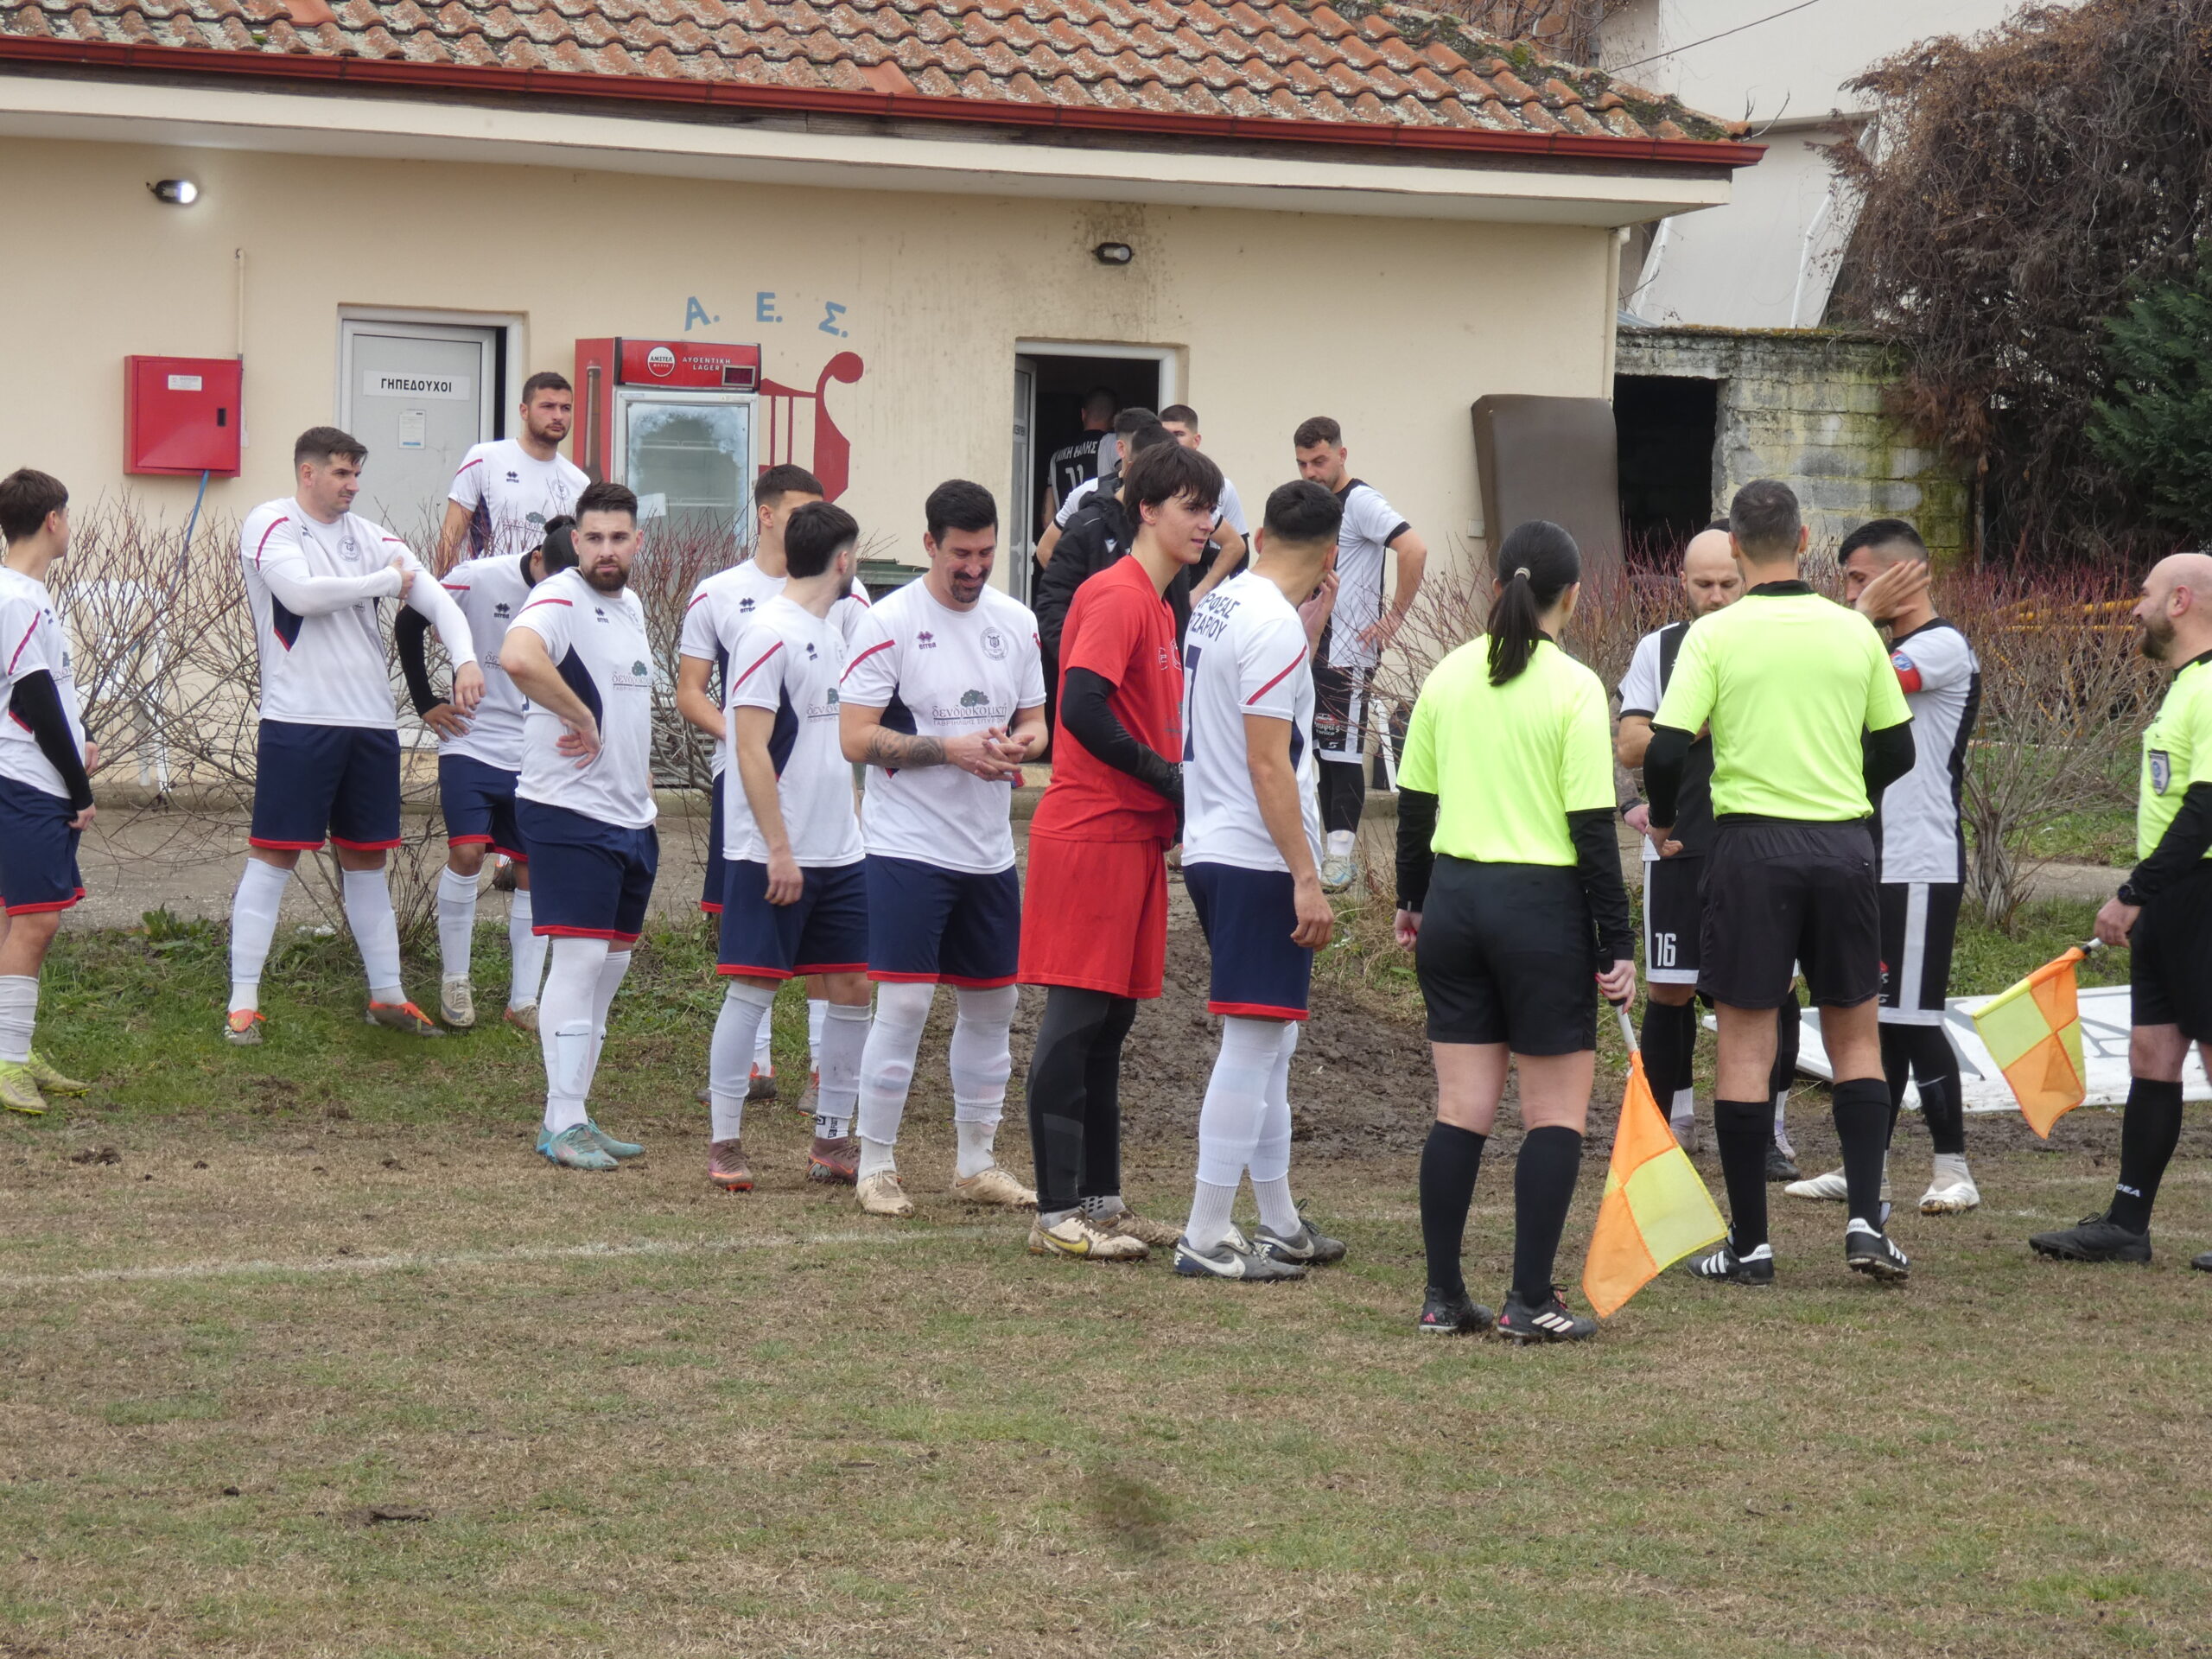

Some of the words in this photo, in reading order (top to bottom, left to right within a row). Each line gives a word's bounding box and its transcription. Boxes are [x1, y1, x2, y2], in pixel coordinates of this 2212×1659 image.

[682, 356, 731, 365] ΑΥΘΕΝΤΙΚΗ
[381, 378, 452, 393] ΓΗΠΕΔΟΥΧΟΙ
[1655, 932, 1676, 967] 16
